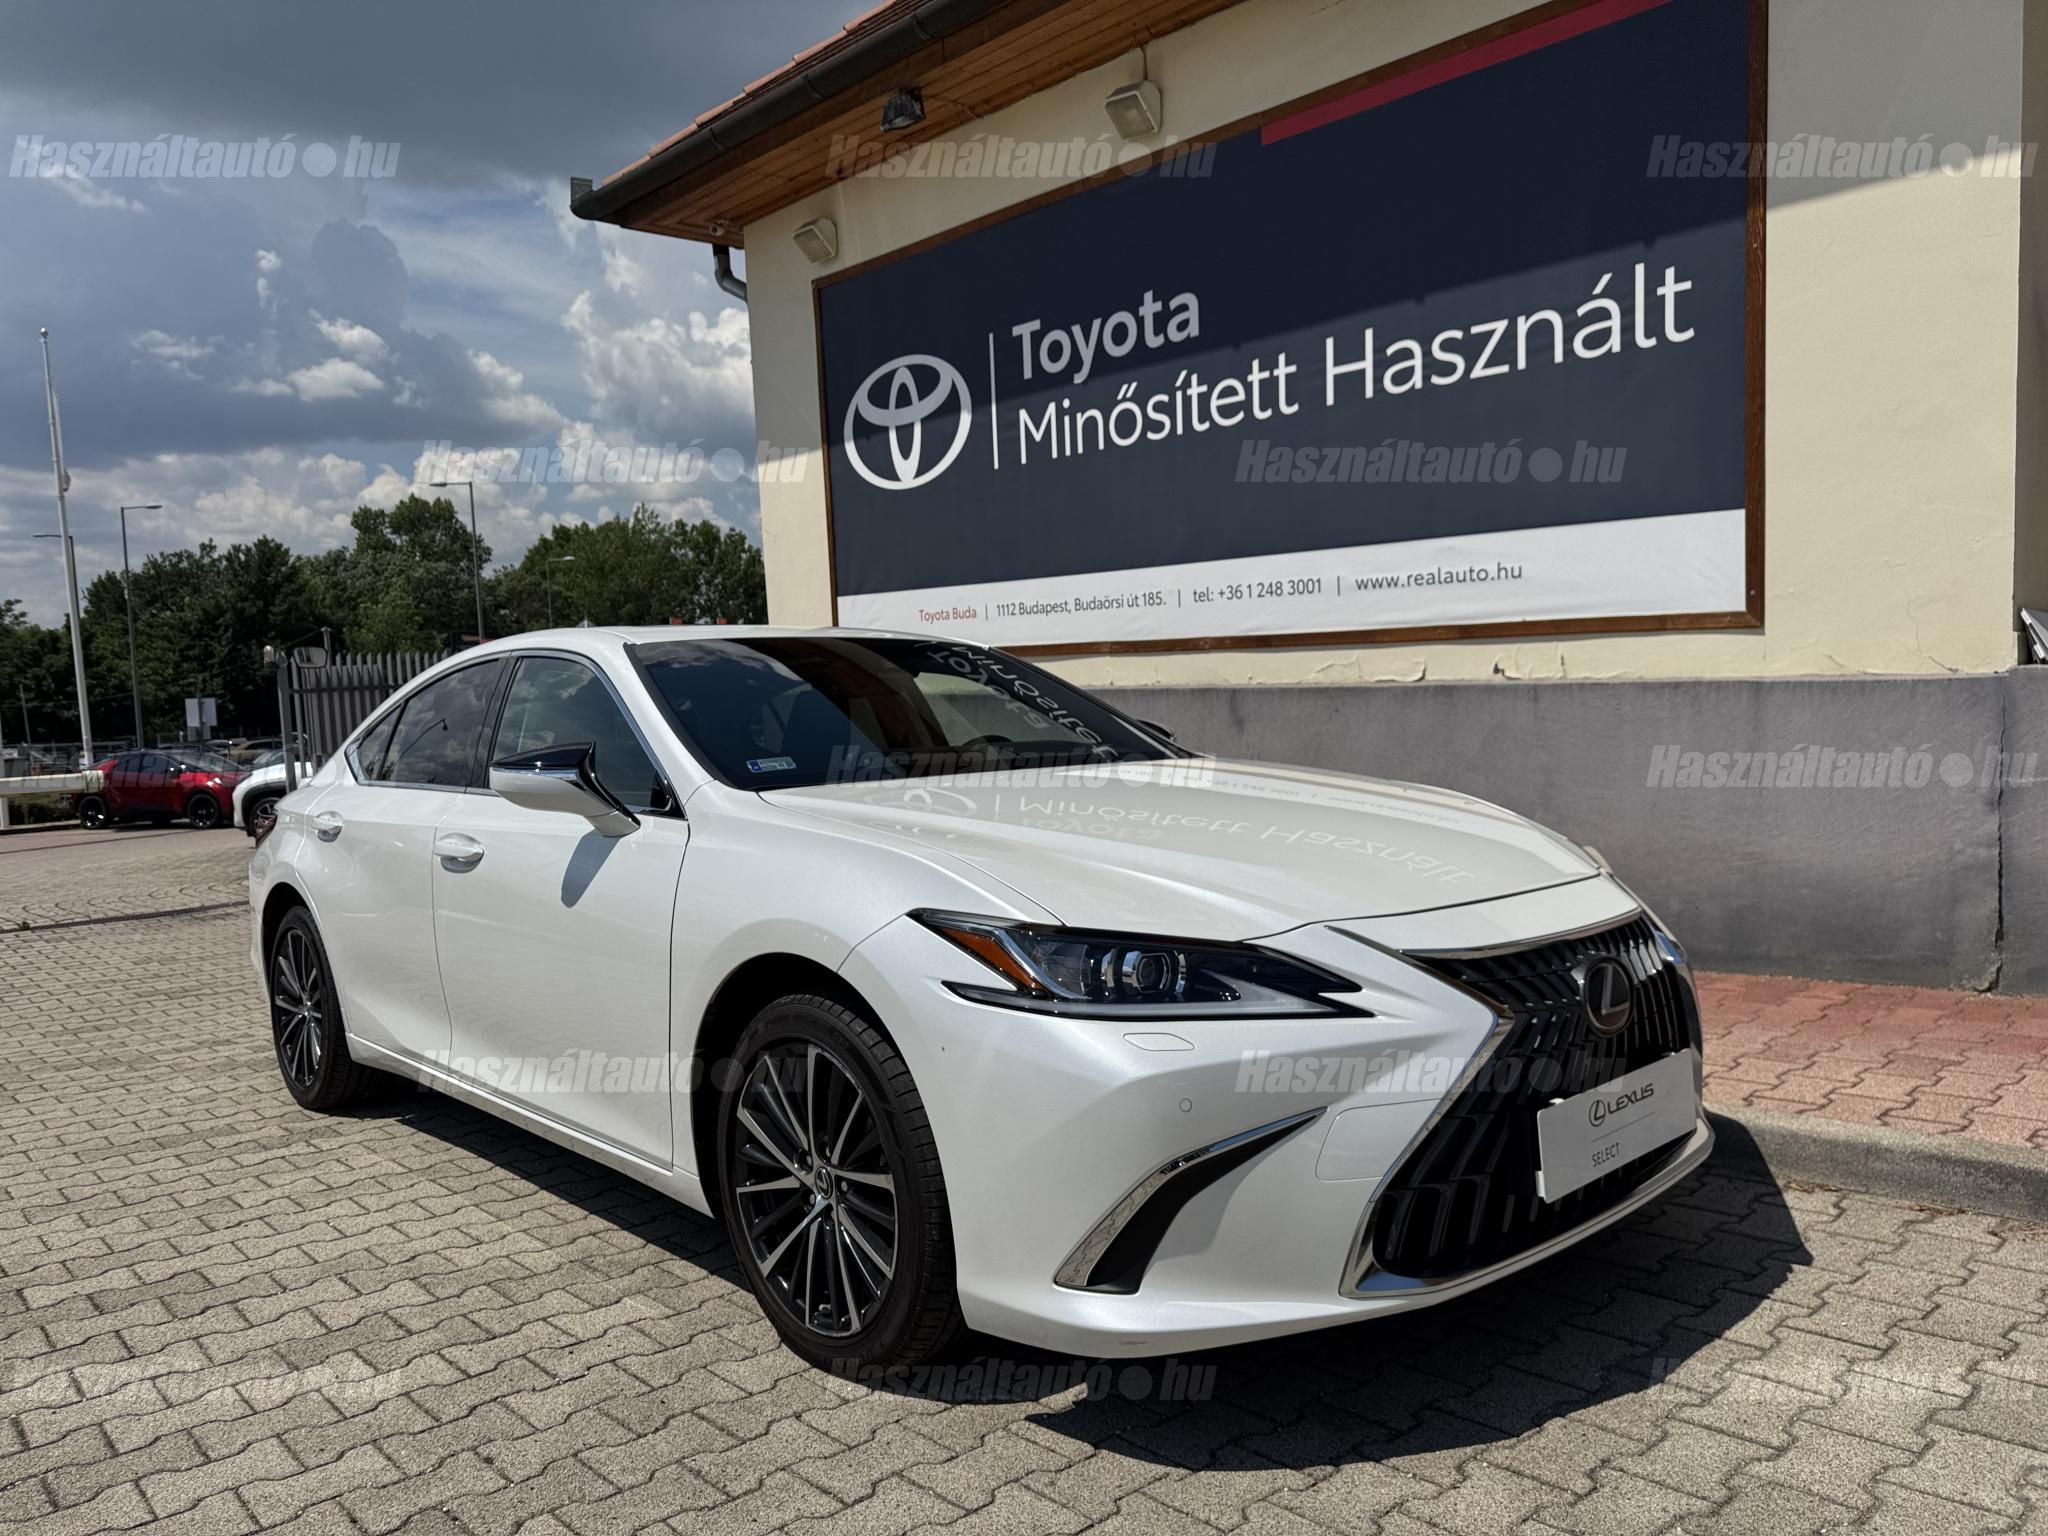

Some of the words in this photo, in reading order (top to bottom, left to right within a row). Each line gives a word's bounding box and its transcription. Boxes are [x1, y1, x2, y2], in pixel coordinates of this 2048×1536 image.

[1012, 290, 1200, 383] Toyota
[1018, 351, 1299, 465] Minősített
[1324, 263, 1695, 406] Használt
[919, 608, 950, 624] Toyota
[952, 606, 977, 619] Buda
[996, 601, 1017, 617] 1112
[1018, 598, 1071, 616] Budapest,
[1074, 593, 1124, 611] Budaörsi
[1126, 594, 1140, 608] út
[1142, 591, 1167, 607] 185.
[1193, 588, 1214, 603] tel:
[1256, 581, 1284, 598] 248
[1287, 577, 1322, 595] 3001
[1355, 562, 1523, 592] www.realauto.hu
[1607, 1082, 1655, 1115] LEXUS
[1592, 1142, 1620, 1168] SELECT
